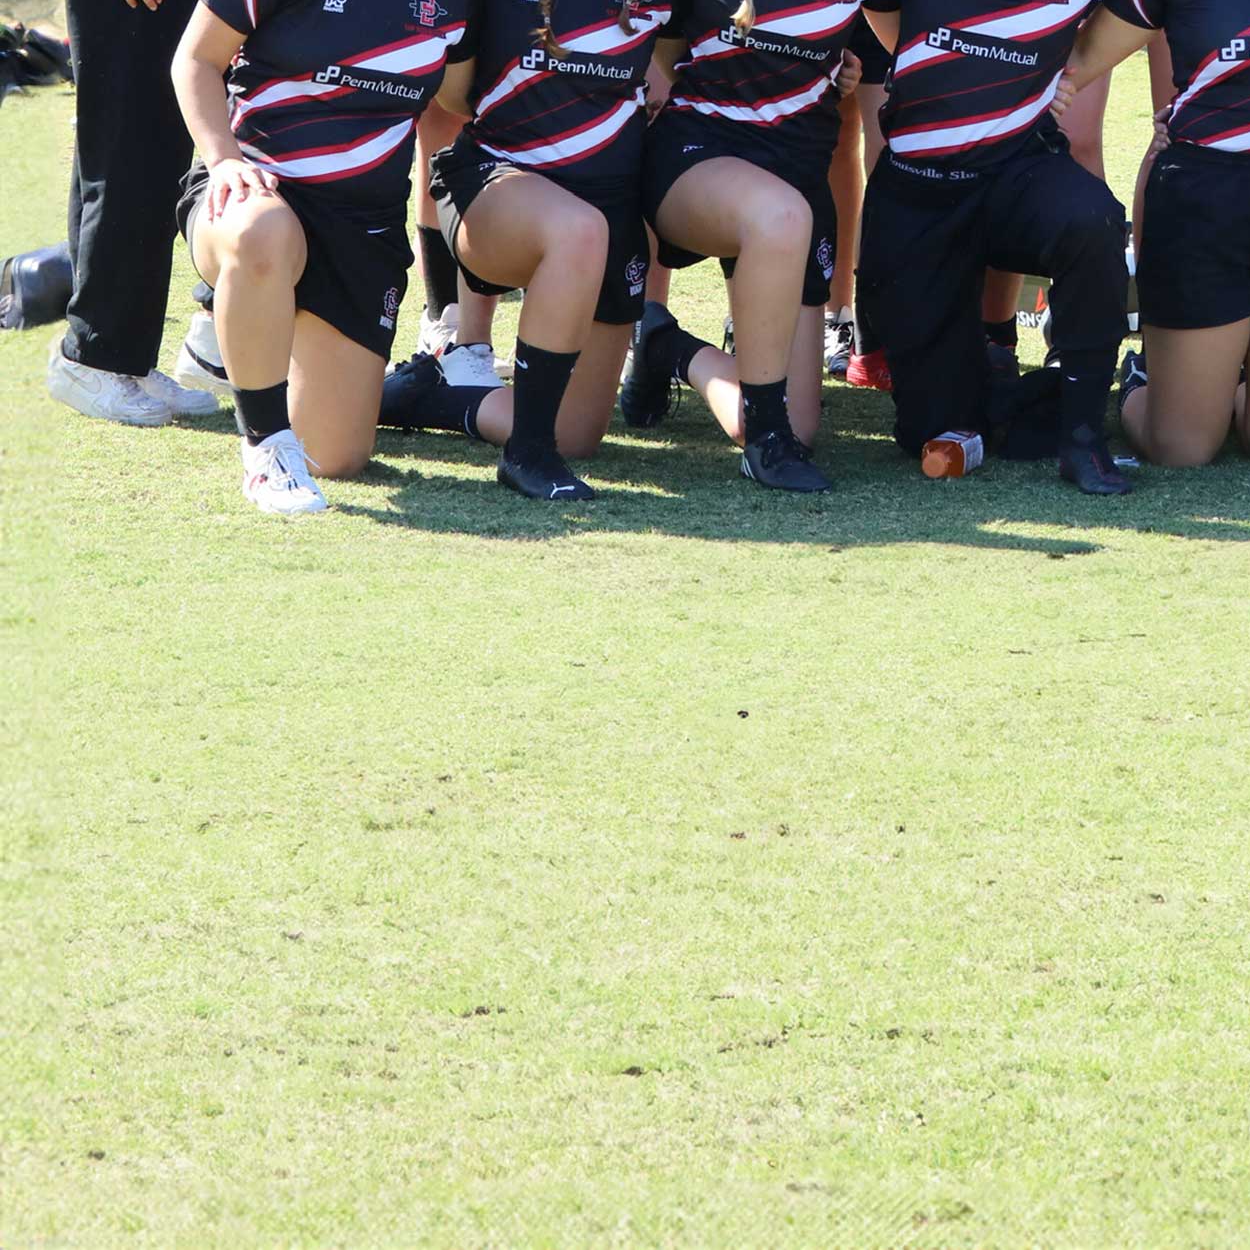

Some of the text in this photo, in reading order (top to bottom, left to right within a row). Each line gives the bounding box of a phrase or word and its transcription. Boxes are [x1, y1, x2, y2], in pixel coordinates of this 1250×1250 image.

[745, 36, 830, 61] PennMutual
[952, 38, 1038, 66] PennMutual
[548, 58, 633, 80] PennMutual
[340, 74, 424, 100] PennMutual
